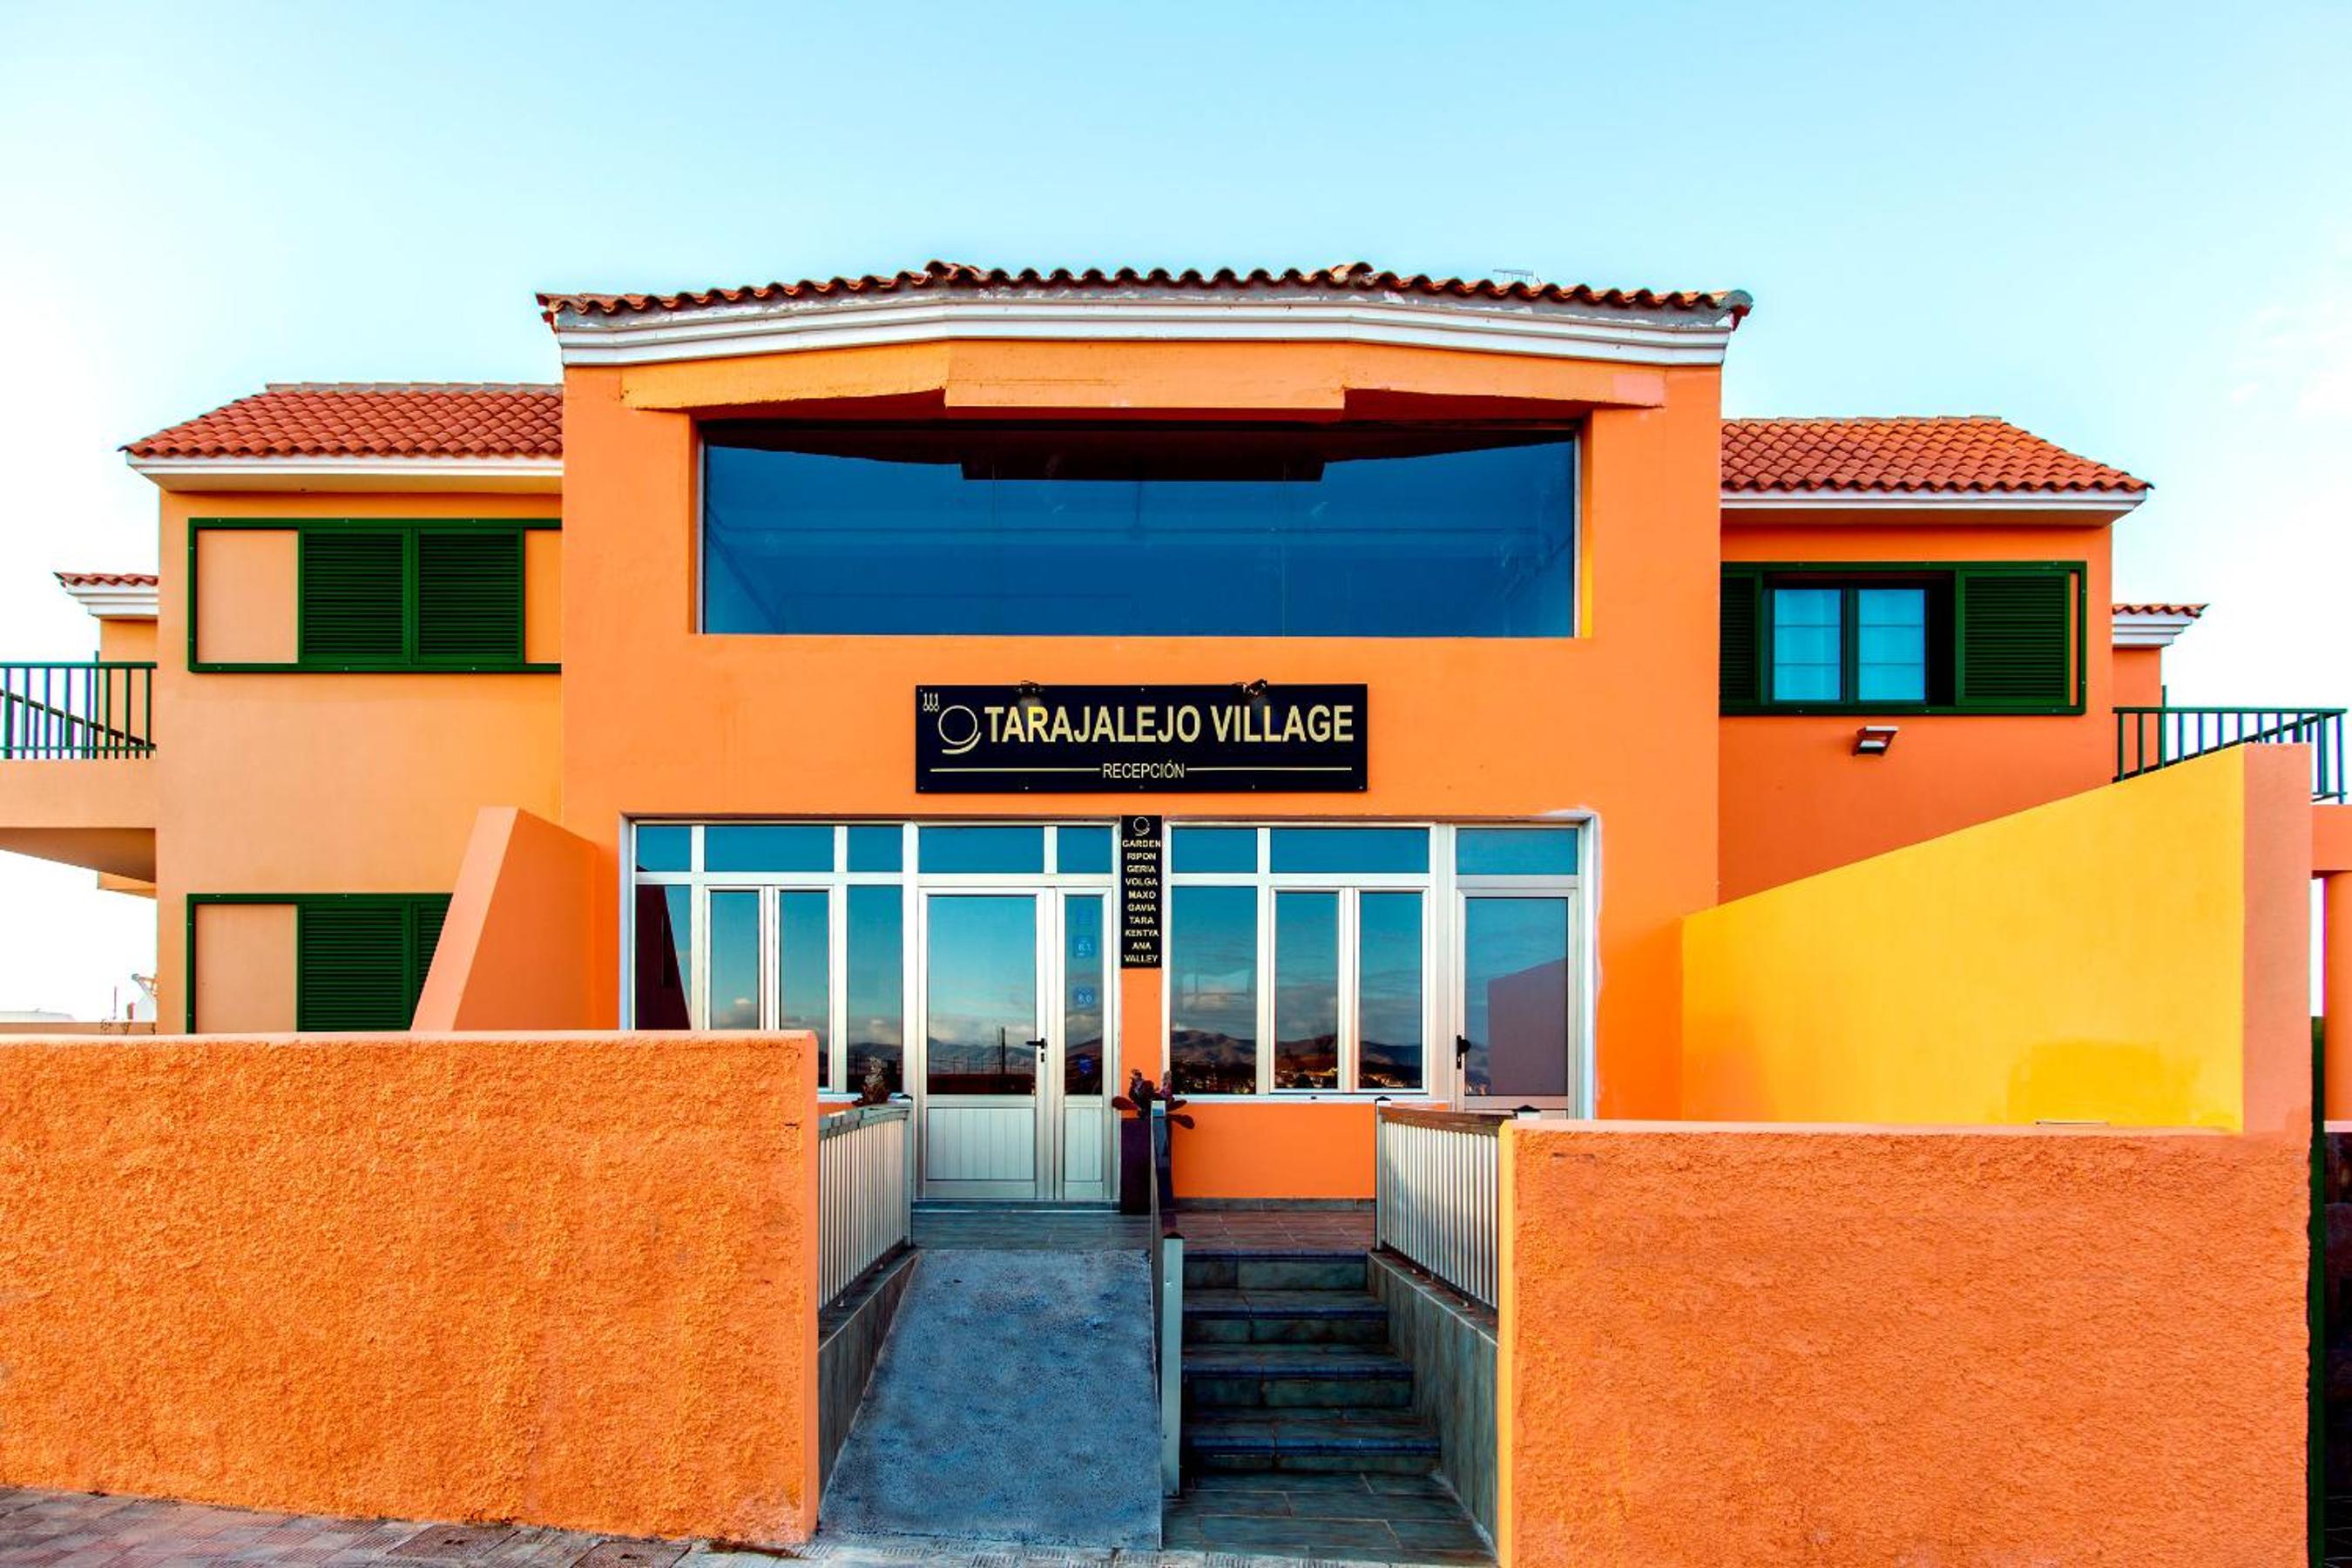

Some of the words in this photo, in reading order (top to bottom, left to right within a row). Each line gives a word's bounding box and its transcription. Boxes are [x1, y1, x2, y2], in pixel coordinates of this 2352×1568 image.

[984, 706, 1200, 743] TARAJALEJO
[1210, 705, 1355, 743] VILLAGE
[1102, 760, 1185, 779] RECEPCIÓN
[1128, 890, 1156, 899] MAXO
[1127, 903, 1157, 912] GAVIA
[1132, 942, 1152, 950] ANA
